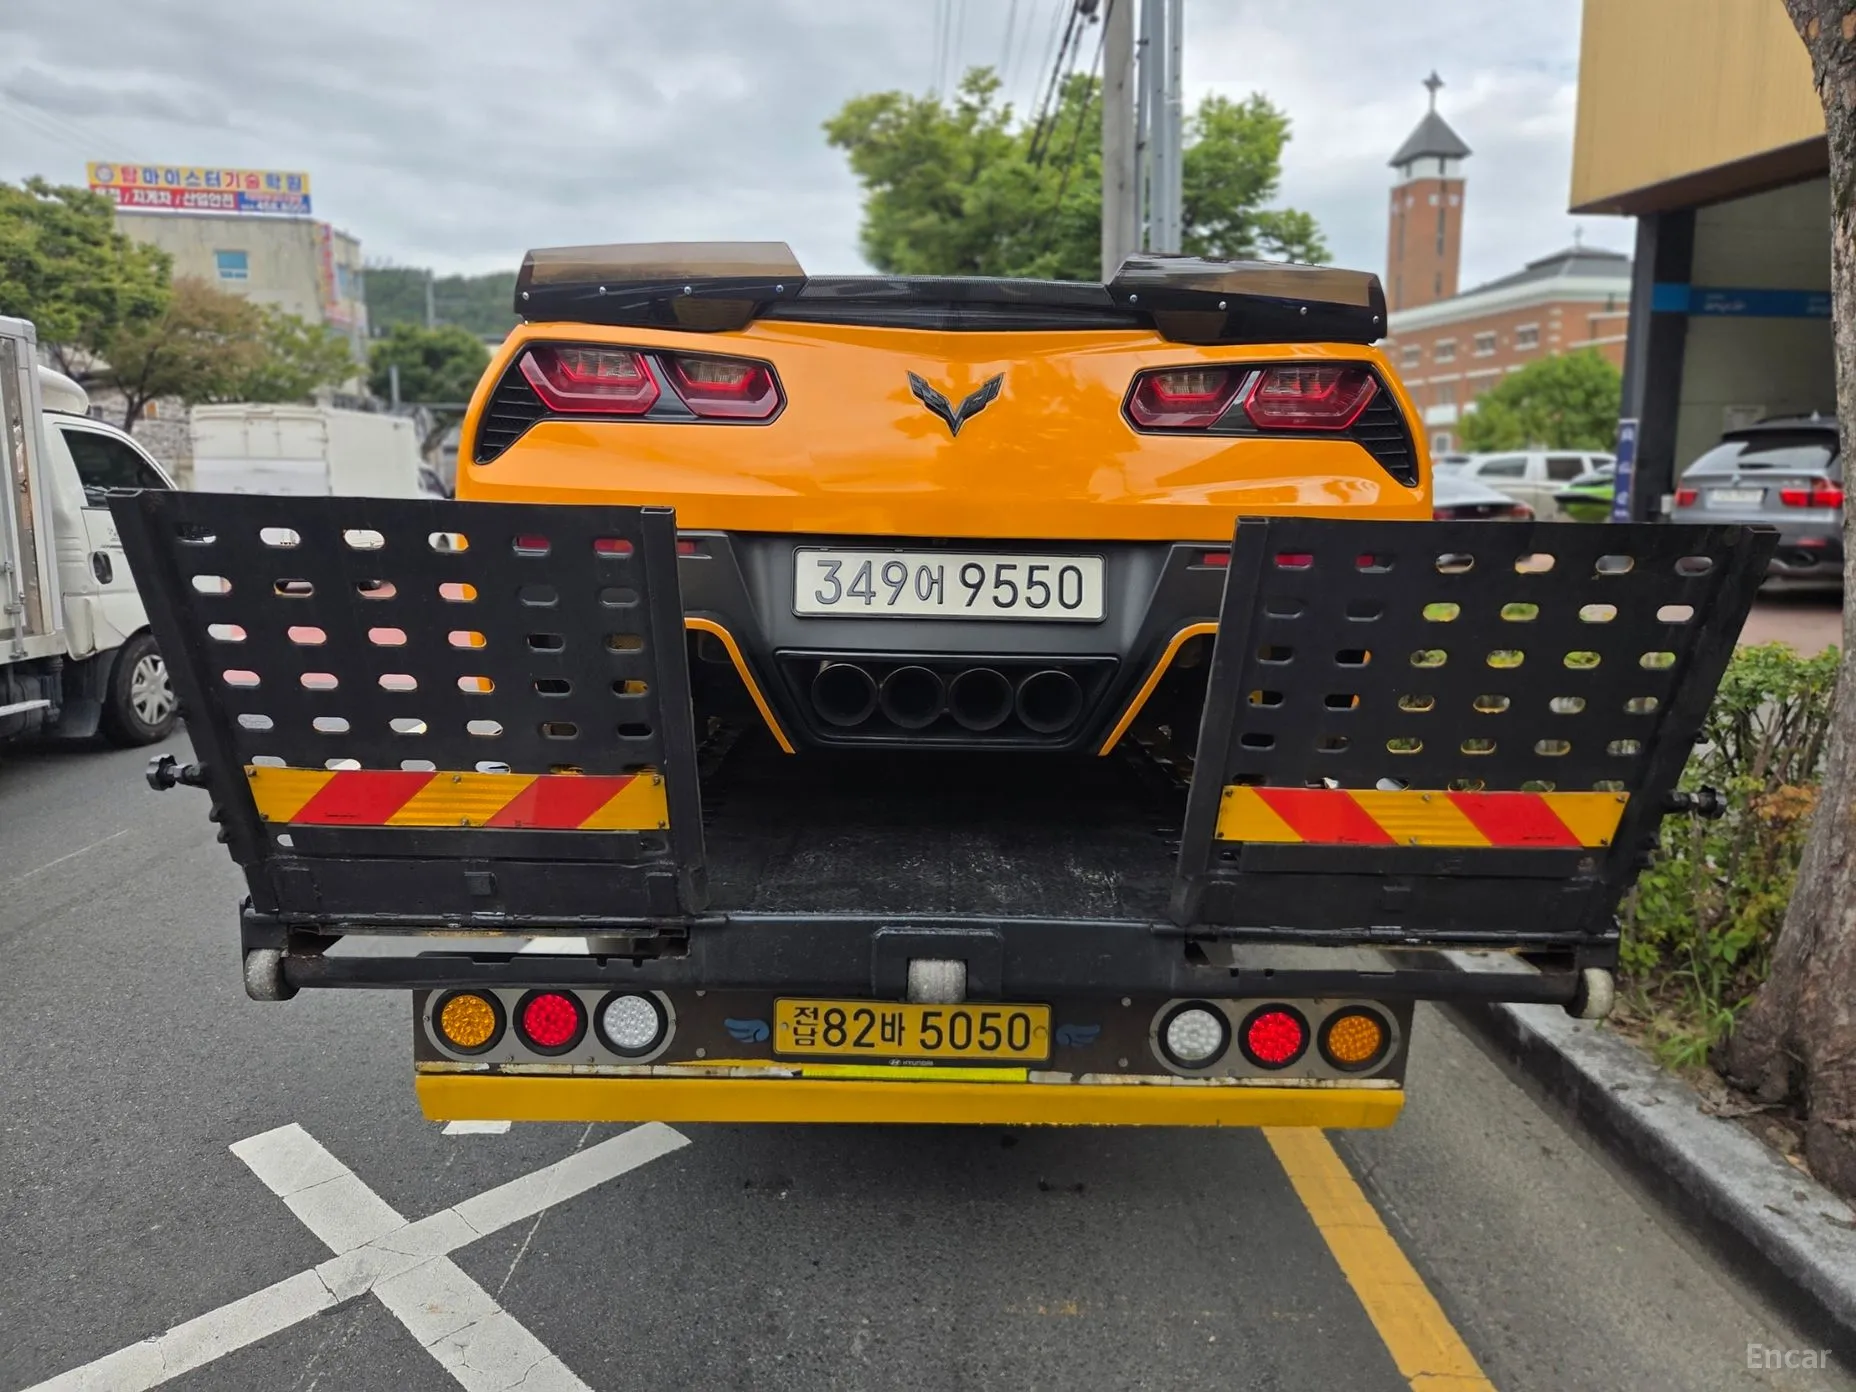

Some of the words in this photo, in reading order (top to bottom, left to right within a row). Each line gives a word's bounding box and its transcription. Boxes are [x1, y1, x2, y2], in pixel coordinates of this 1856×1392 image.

[815, 560, 944, 605] 349어
[958, 562, 1083, 610] 9550
[823, 1007, 905, 1048] 82바
[919, 1011, 1031, 1051] 5050
